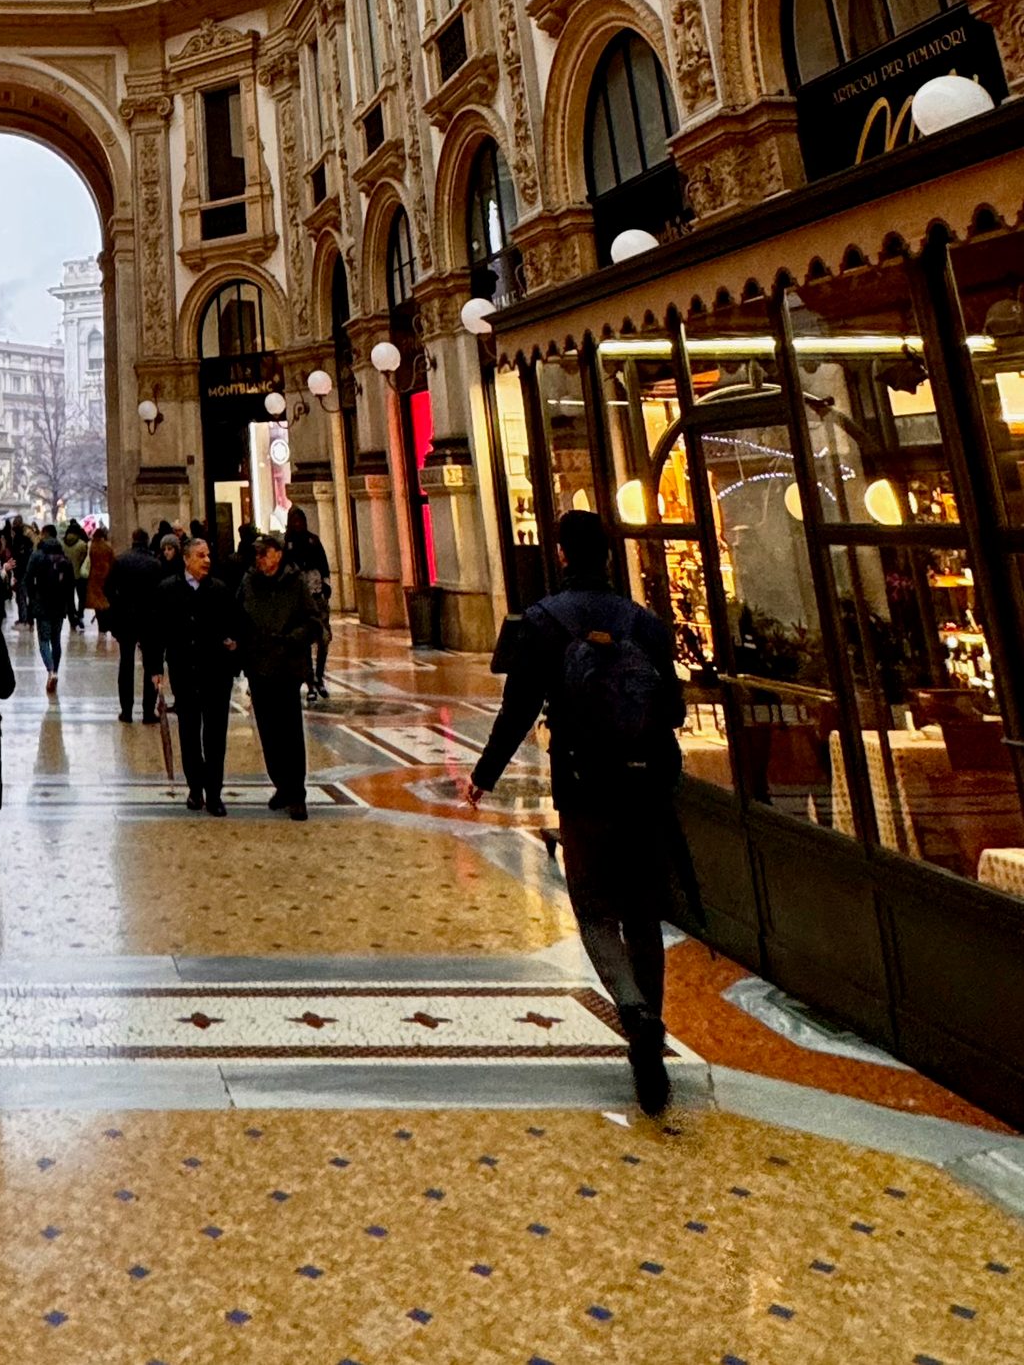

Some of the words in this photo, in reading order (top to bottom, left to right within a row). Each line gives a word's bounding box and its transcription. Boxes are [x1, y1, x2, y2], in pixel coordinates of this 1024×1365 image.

[881, 58, 905, 82] PER
[907, 26, 967, 69] FUMATORI
[207, 380, 274, 397] MONTBLANC
